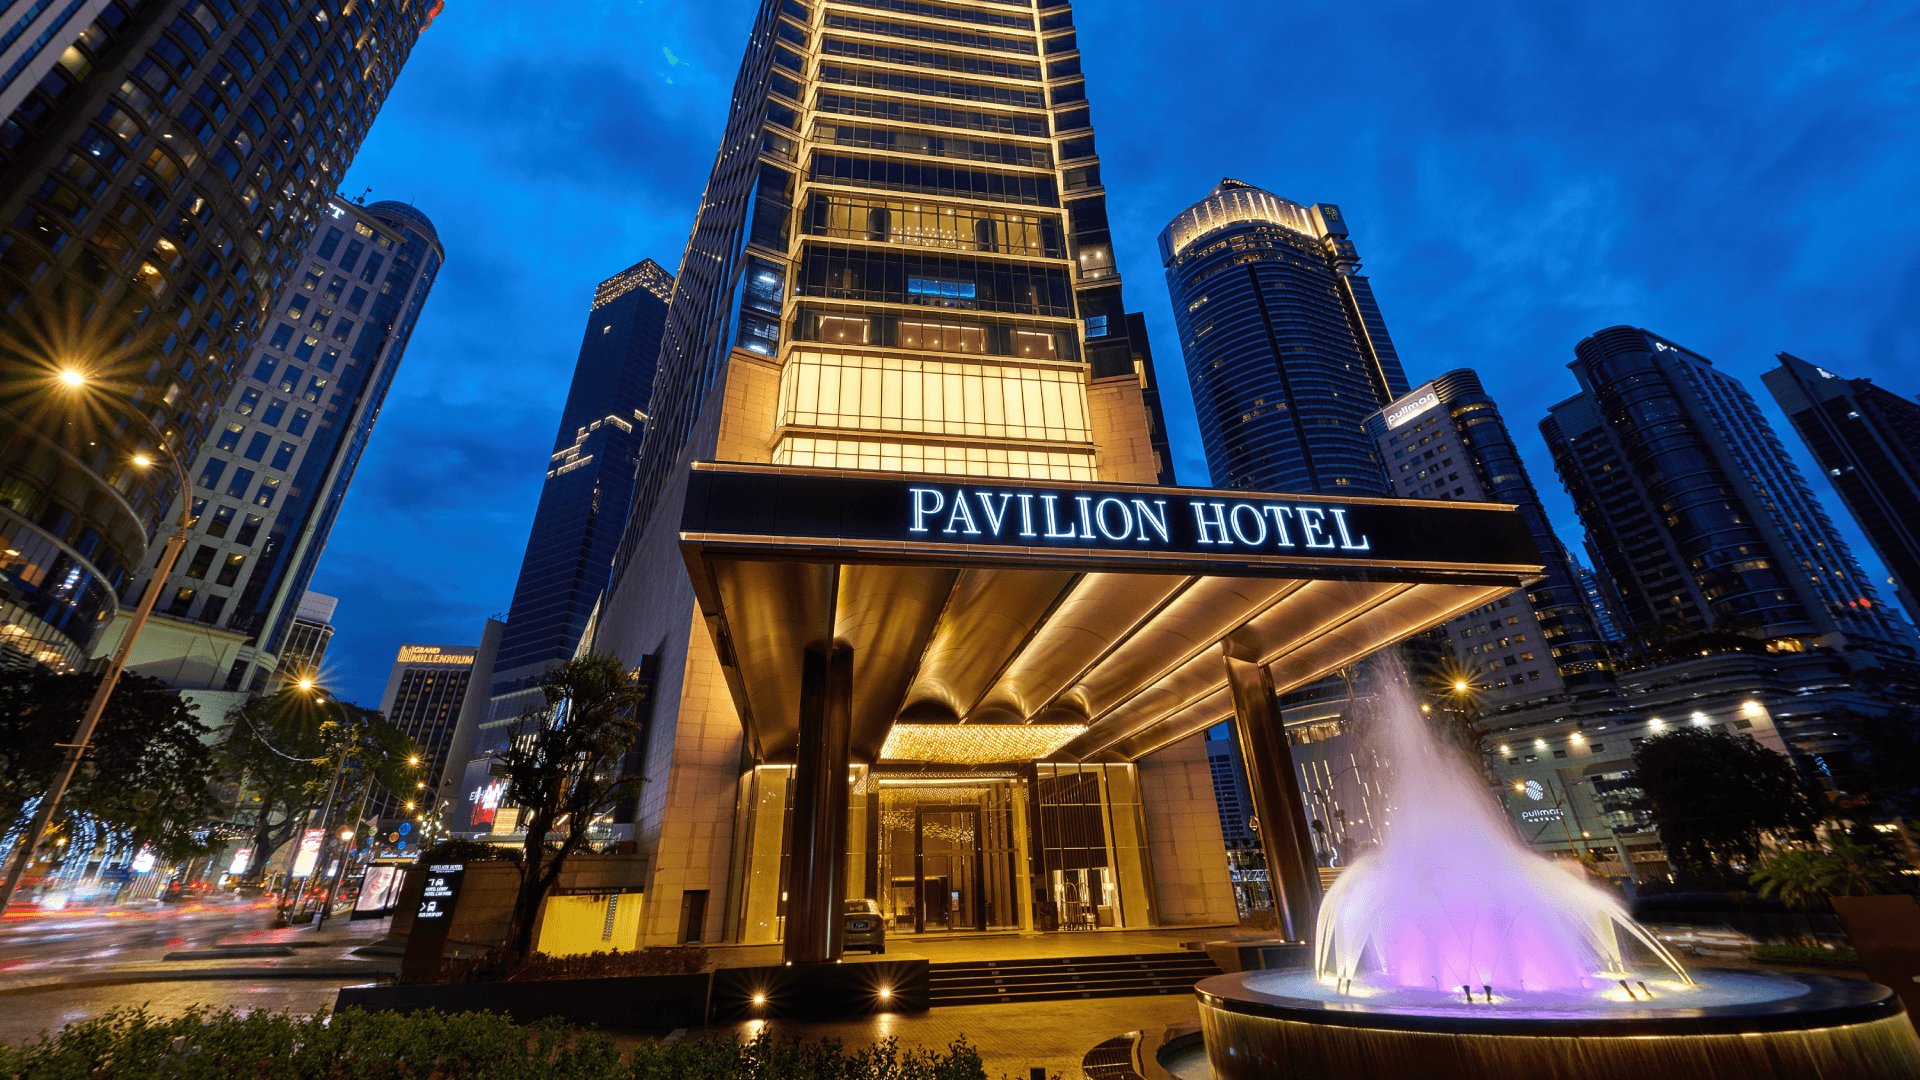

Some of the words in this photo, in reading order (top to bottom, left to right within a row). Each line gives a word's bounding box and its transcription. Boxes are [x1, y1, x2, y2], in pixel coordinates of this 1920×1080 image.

[1387, 392, 1436, 426] pullman
[909, 488, 1170, 543] PAVILION
[1190, 502, 1370, 550] HOTEL
[414, 646, 440, 654] GRAND
[411, 654, 474, 664] MILLENNIUM
[1521, 808, 1564, 820] pullman
